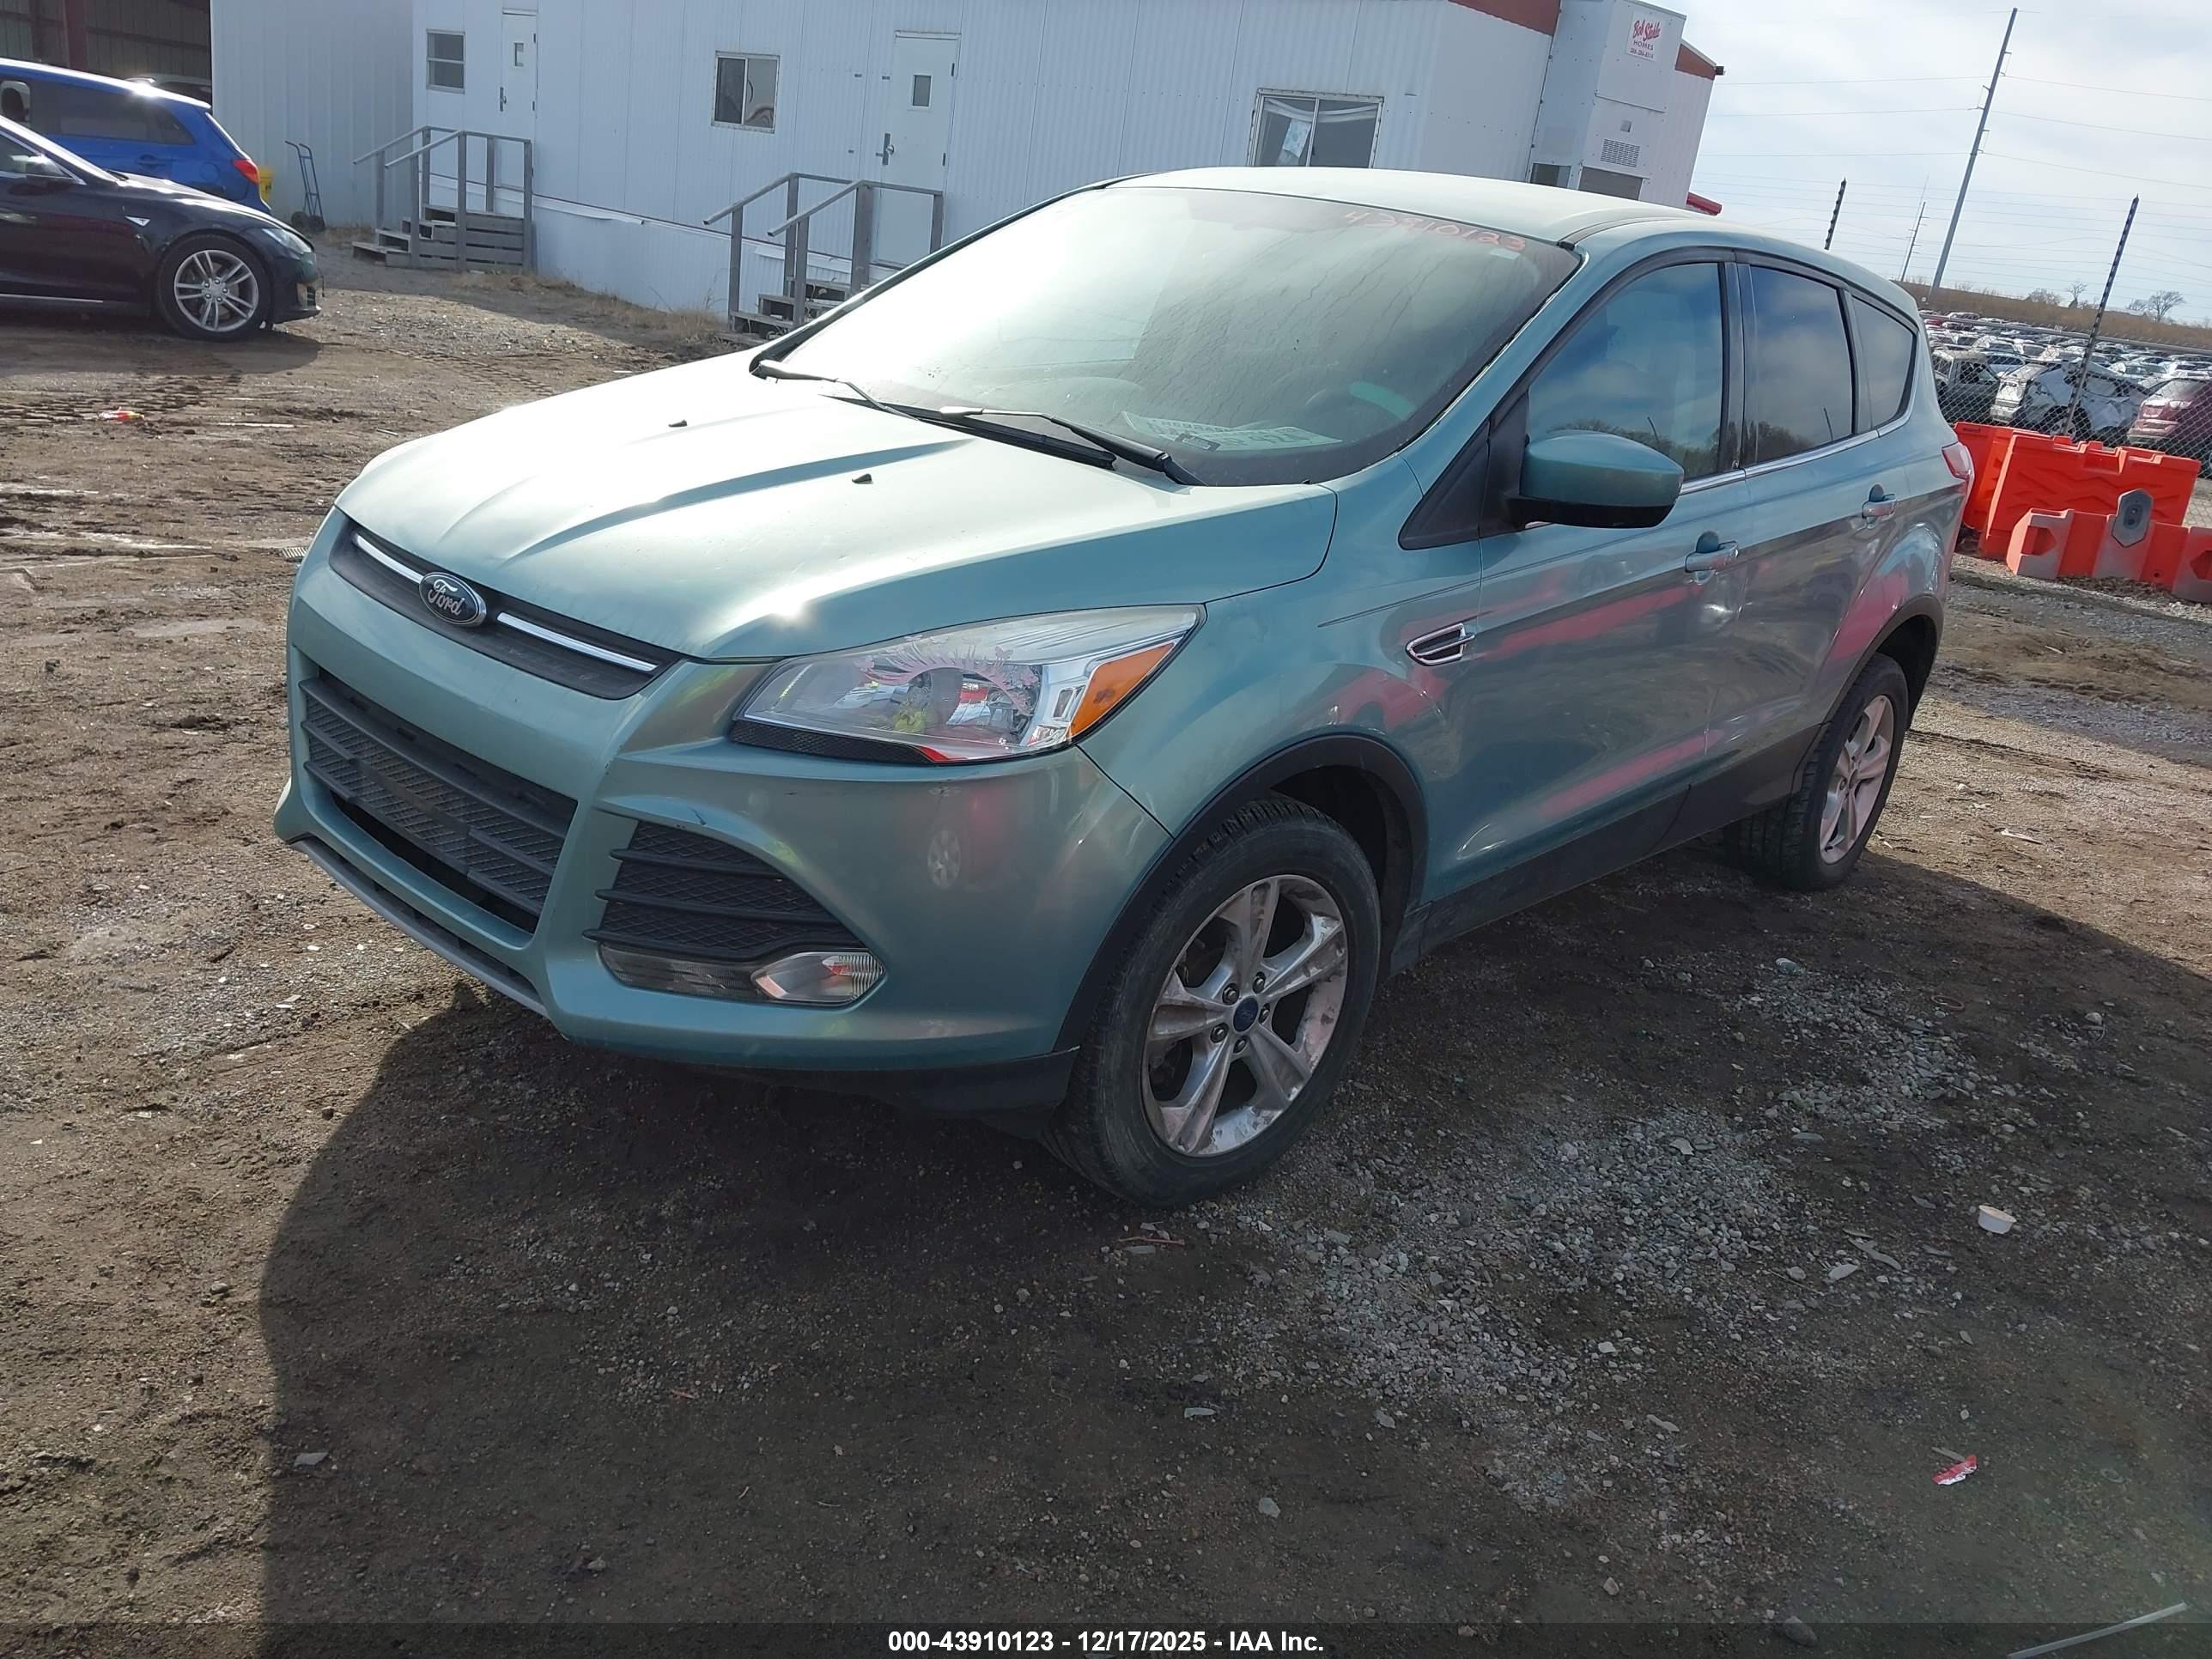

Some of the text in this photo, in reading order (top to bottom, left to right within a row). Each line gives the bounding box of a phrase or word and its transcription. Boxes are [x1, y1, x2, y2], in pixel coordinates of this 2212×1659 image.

[1633, 40, 1654, 51] HOMES
[1345, 211, 1526, 252] 43910123
[428, 579, 465, 616] Ford
